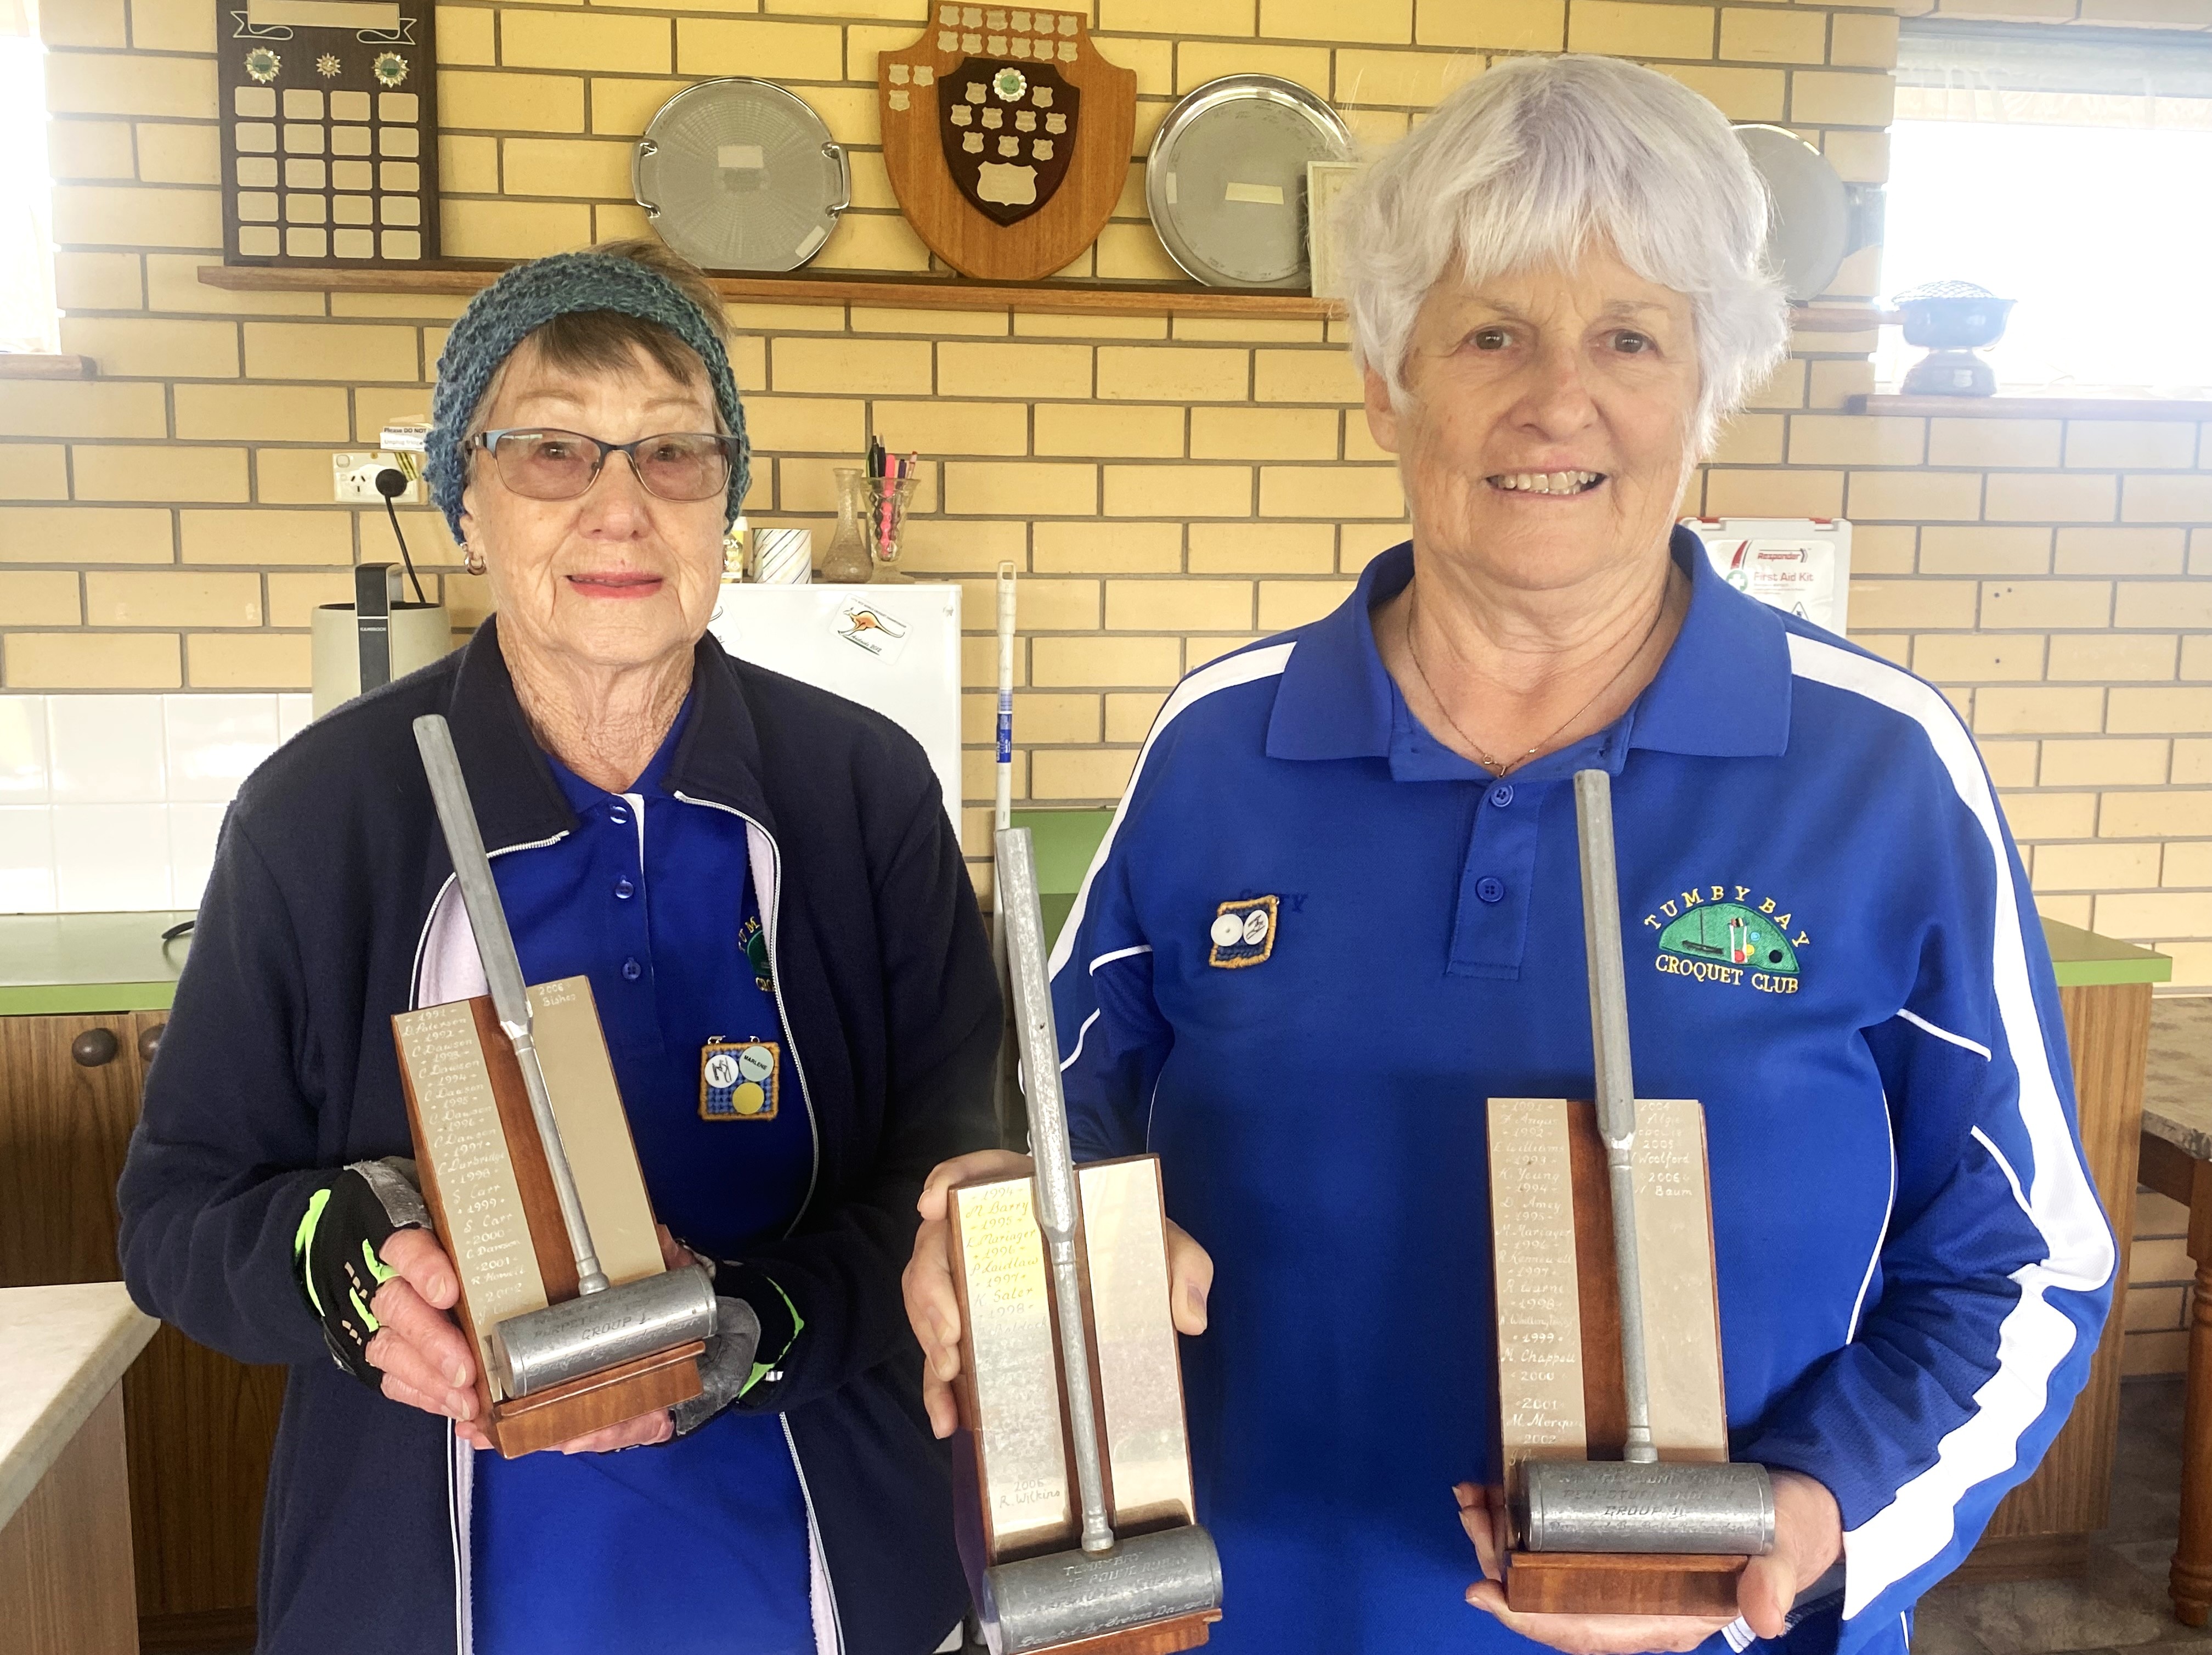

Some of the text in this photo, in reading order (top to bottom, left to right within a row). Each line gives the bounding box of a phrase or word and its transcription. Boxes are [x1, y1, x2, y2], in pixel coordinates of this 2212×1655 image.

[1758, 551, 1801, 561] Responder
[1754, 572, 1813, 581] First Aid Kit
[1644, 886, 1810, 947] TUMBY BAY
[1656, 954, 1798, 993] CROQUET CLUB
[744, 1055, 768, 1071] MARLENE
[1514, 1128, 1544, 1138] 1992
[1518, 1168, 1560, 1183] Young
[983, 1187, 1014, 1200] 1994
[1656, 1185, 1692, 1196] Baum
[990, 1201, 1029, 1215] Barry
[981, 1217, 1012, 1229] 1995
[473, 1230, 505, 1245] 2000
[982, 1246, 1015, 1260] 1996
[480, 1257, 510, 1271] 2001
[982, 1257, 1039, 1274] Laidlaw
[987, 1273, 1018, 1287] 1997
[990, 1303, 1024, 1319] 1998
[581, 1316, 631, 1340] GROUP
[1522, 1332, 1554, 1343] 1999
[1521, 1372, 1554, 1381] 2000
[1522, 1398, 1559, 1410] 2001
[1017, 1490, 1060, 1504] Wilkins
[1604, 1505, 1661, 1516] GROUP
